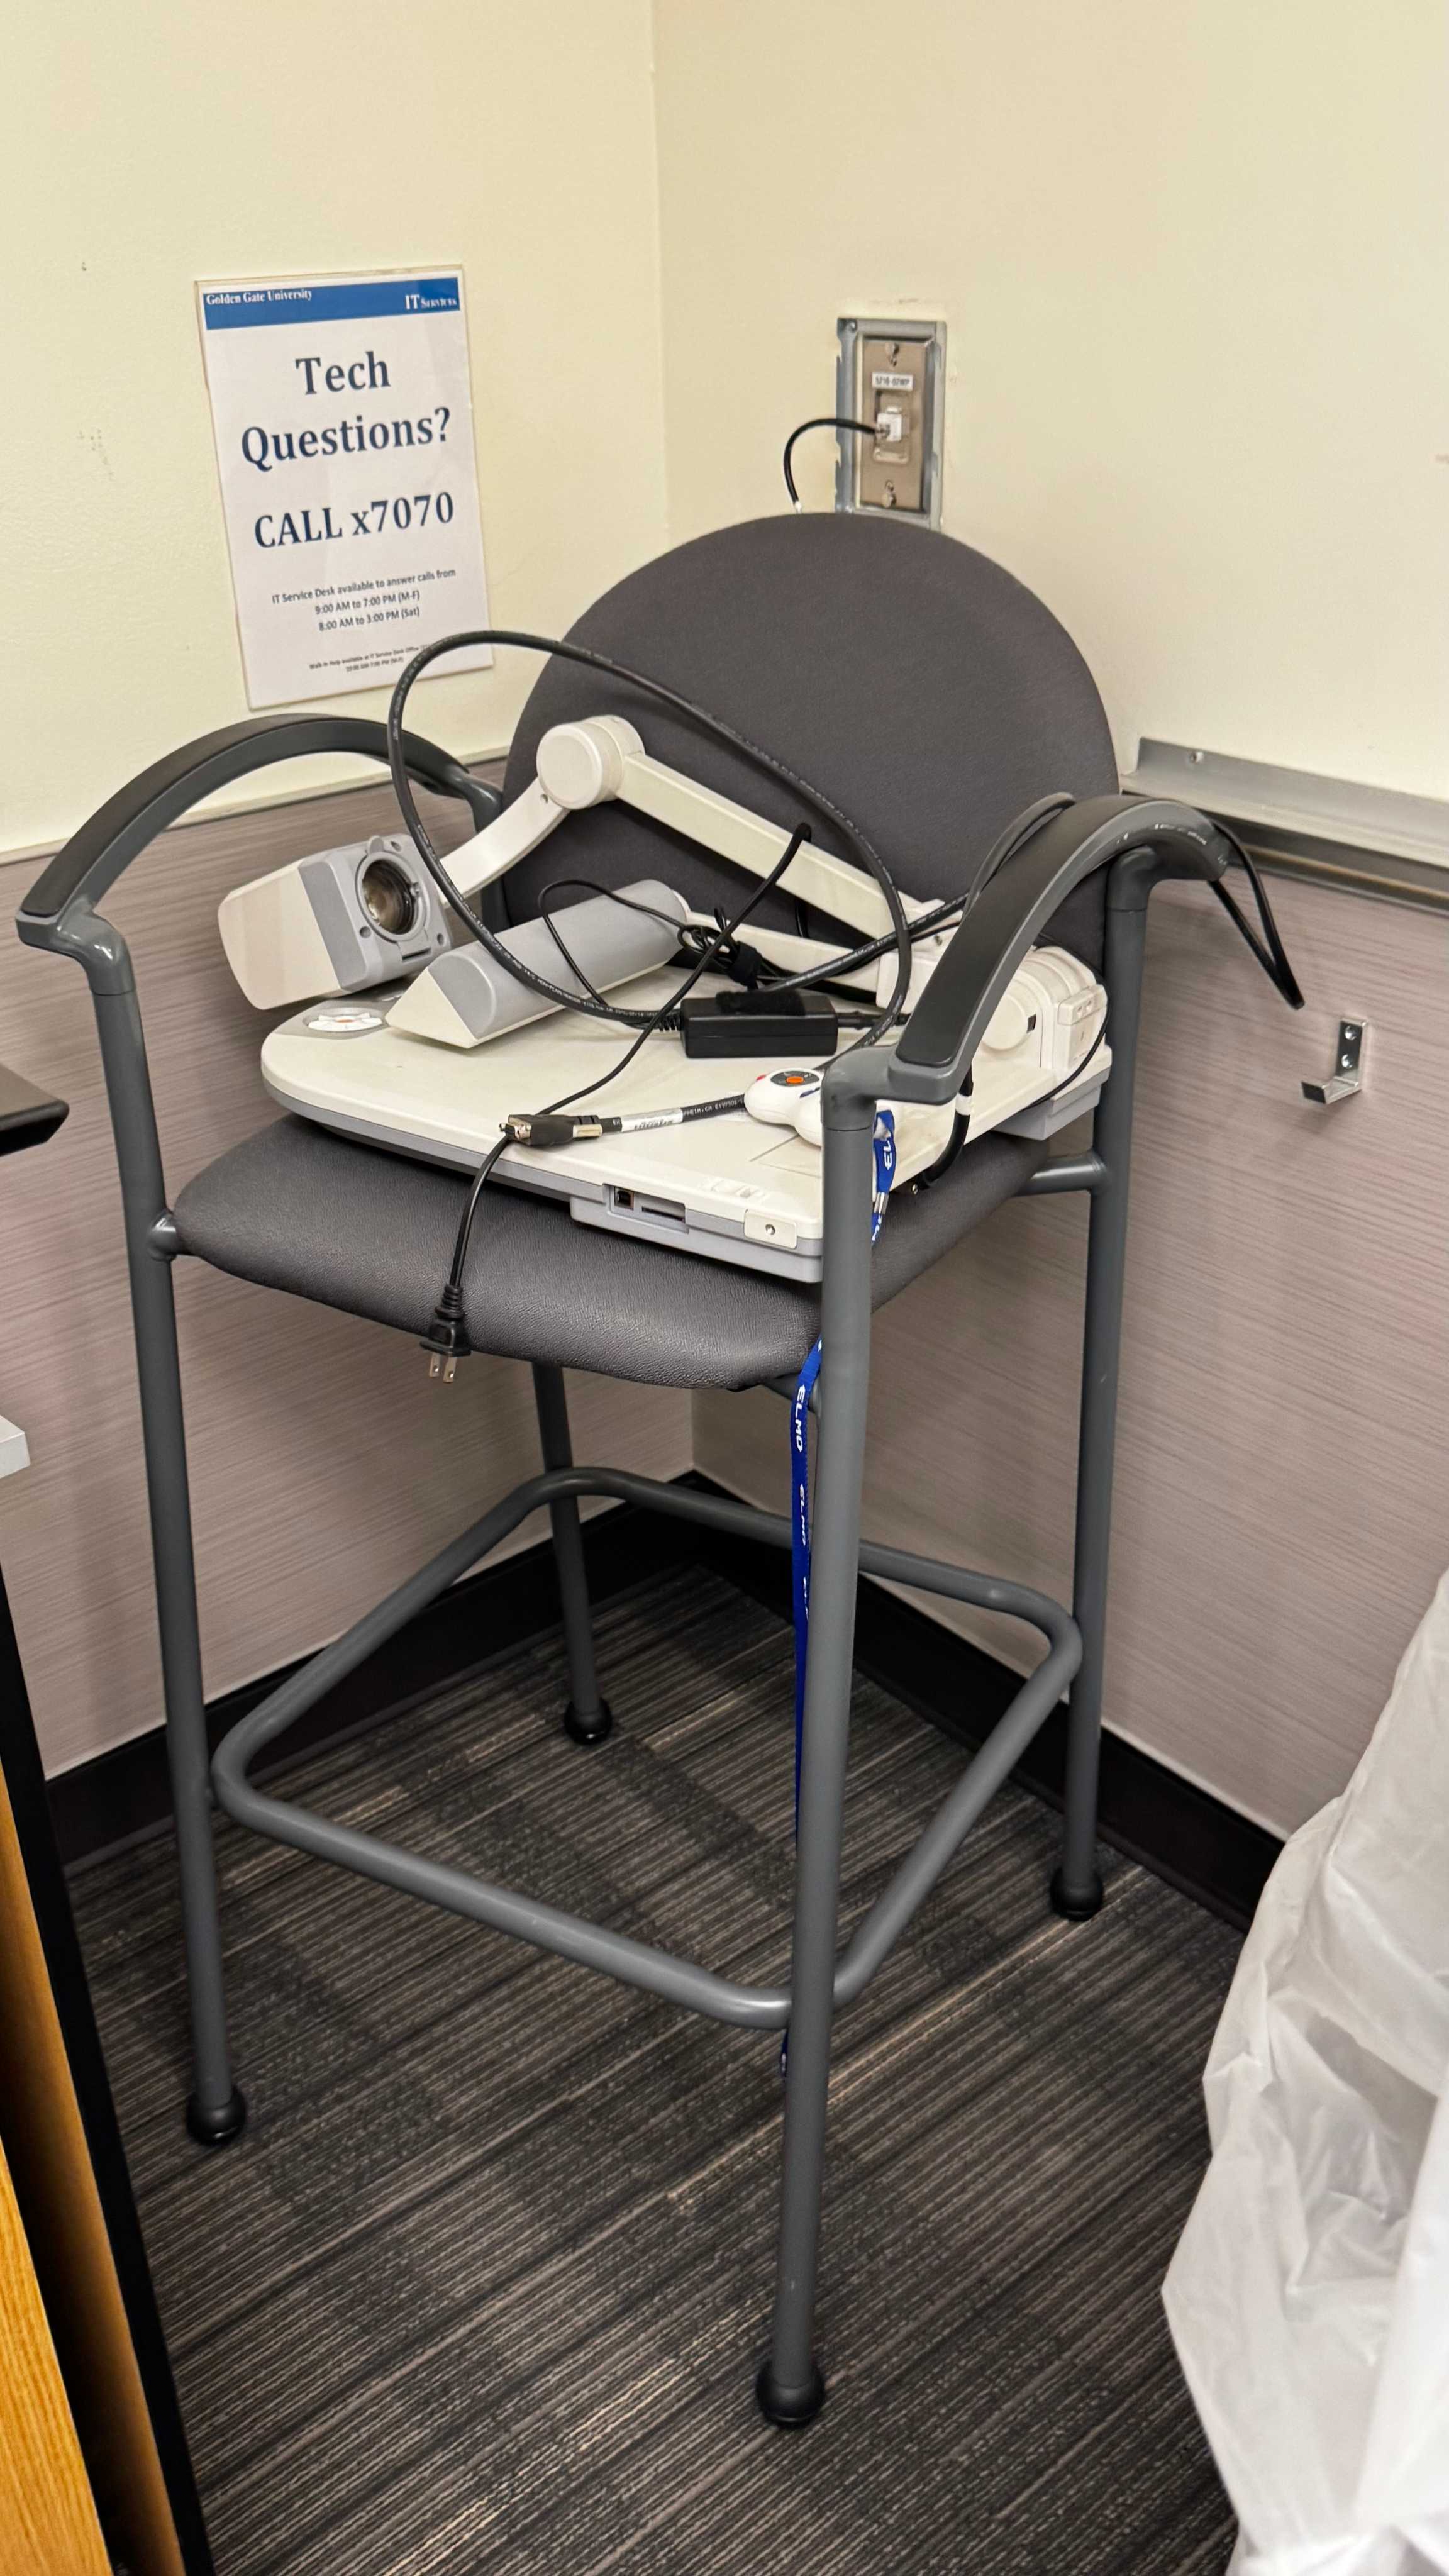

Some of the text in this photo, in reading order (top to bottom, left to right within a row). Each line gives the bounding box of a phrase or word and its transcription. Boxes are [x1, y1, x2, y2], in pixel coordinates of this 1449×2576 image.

[206, 289, 312, 305] Golden Gate University
[406, 295, 419, 309] IT
[296, 351, 391, 395] Tech
[242, 407, 450, 472] Questions?
[255, 492, 453, 548] CALL x7070
[272, 569, 455, 604] IT Service Desk available to answer calls from
[315, 590, 420, 615] 9:00 AM to 7:00 PM (M-F)
[339, 618, 353, 628] AM
[356, 616, 364, 625] to
[367, 613, 384, 623] 3:00
[386, 611, 399, 621] PM
[401, 607, 419, 619] (Sat)
[883, 1140, 892, 1170] EL
[795, 1384, 806, 1453] ELMO
